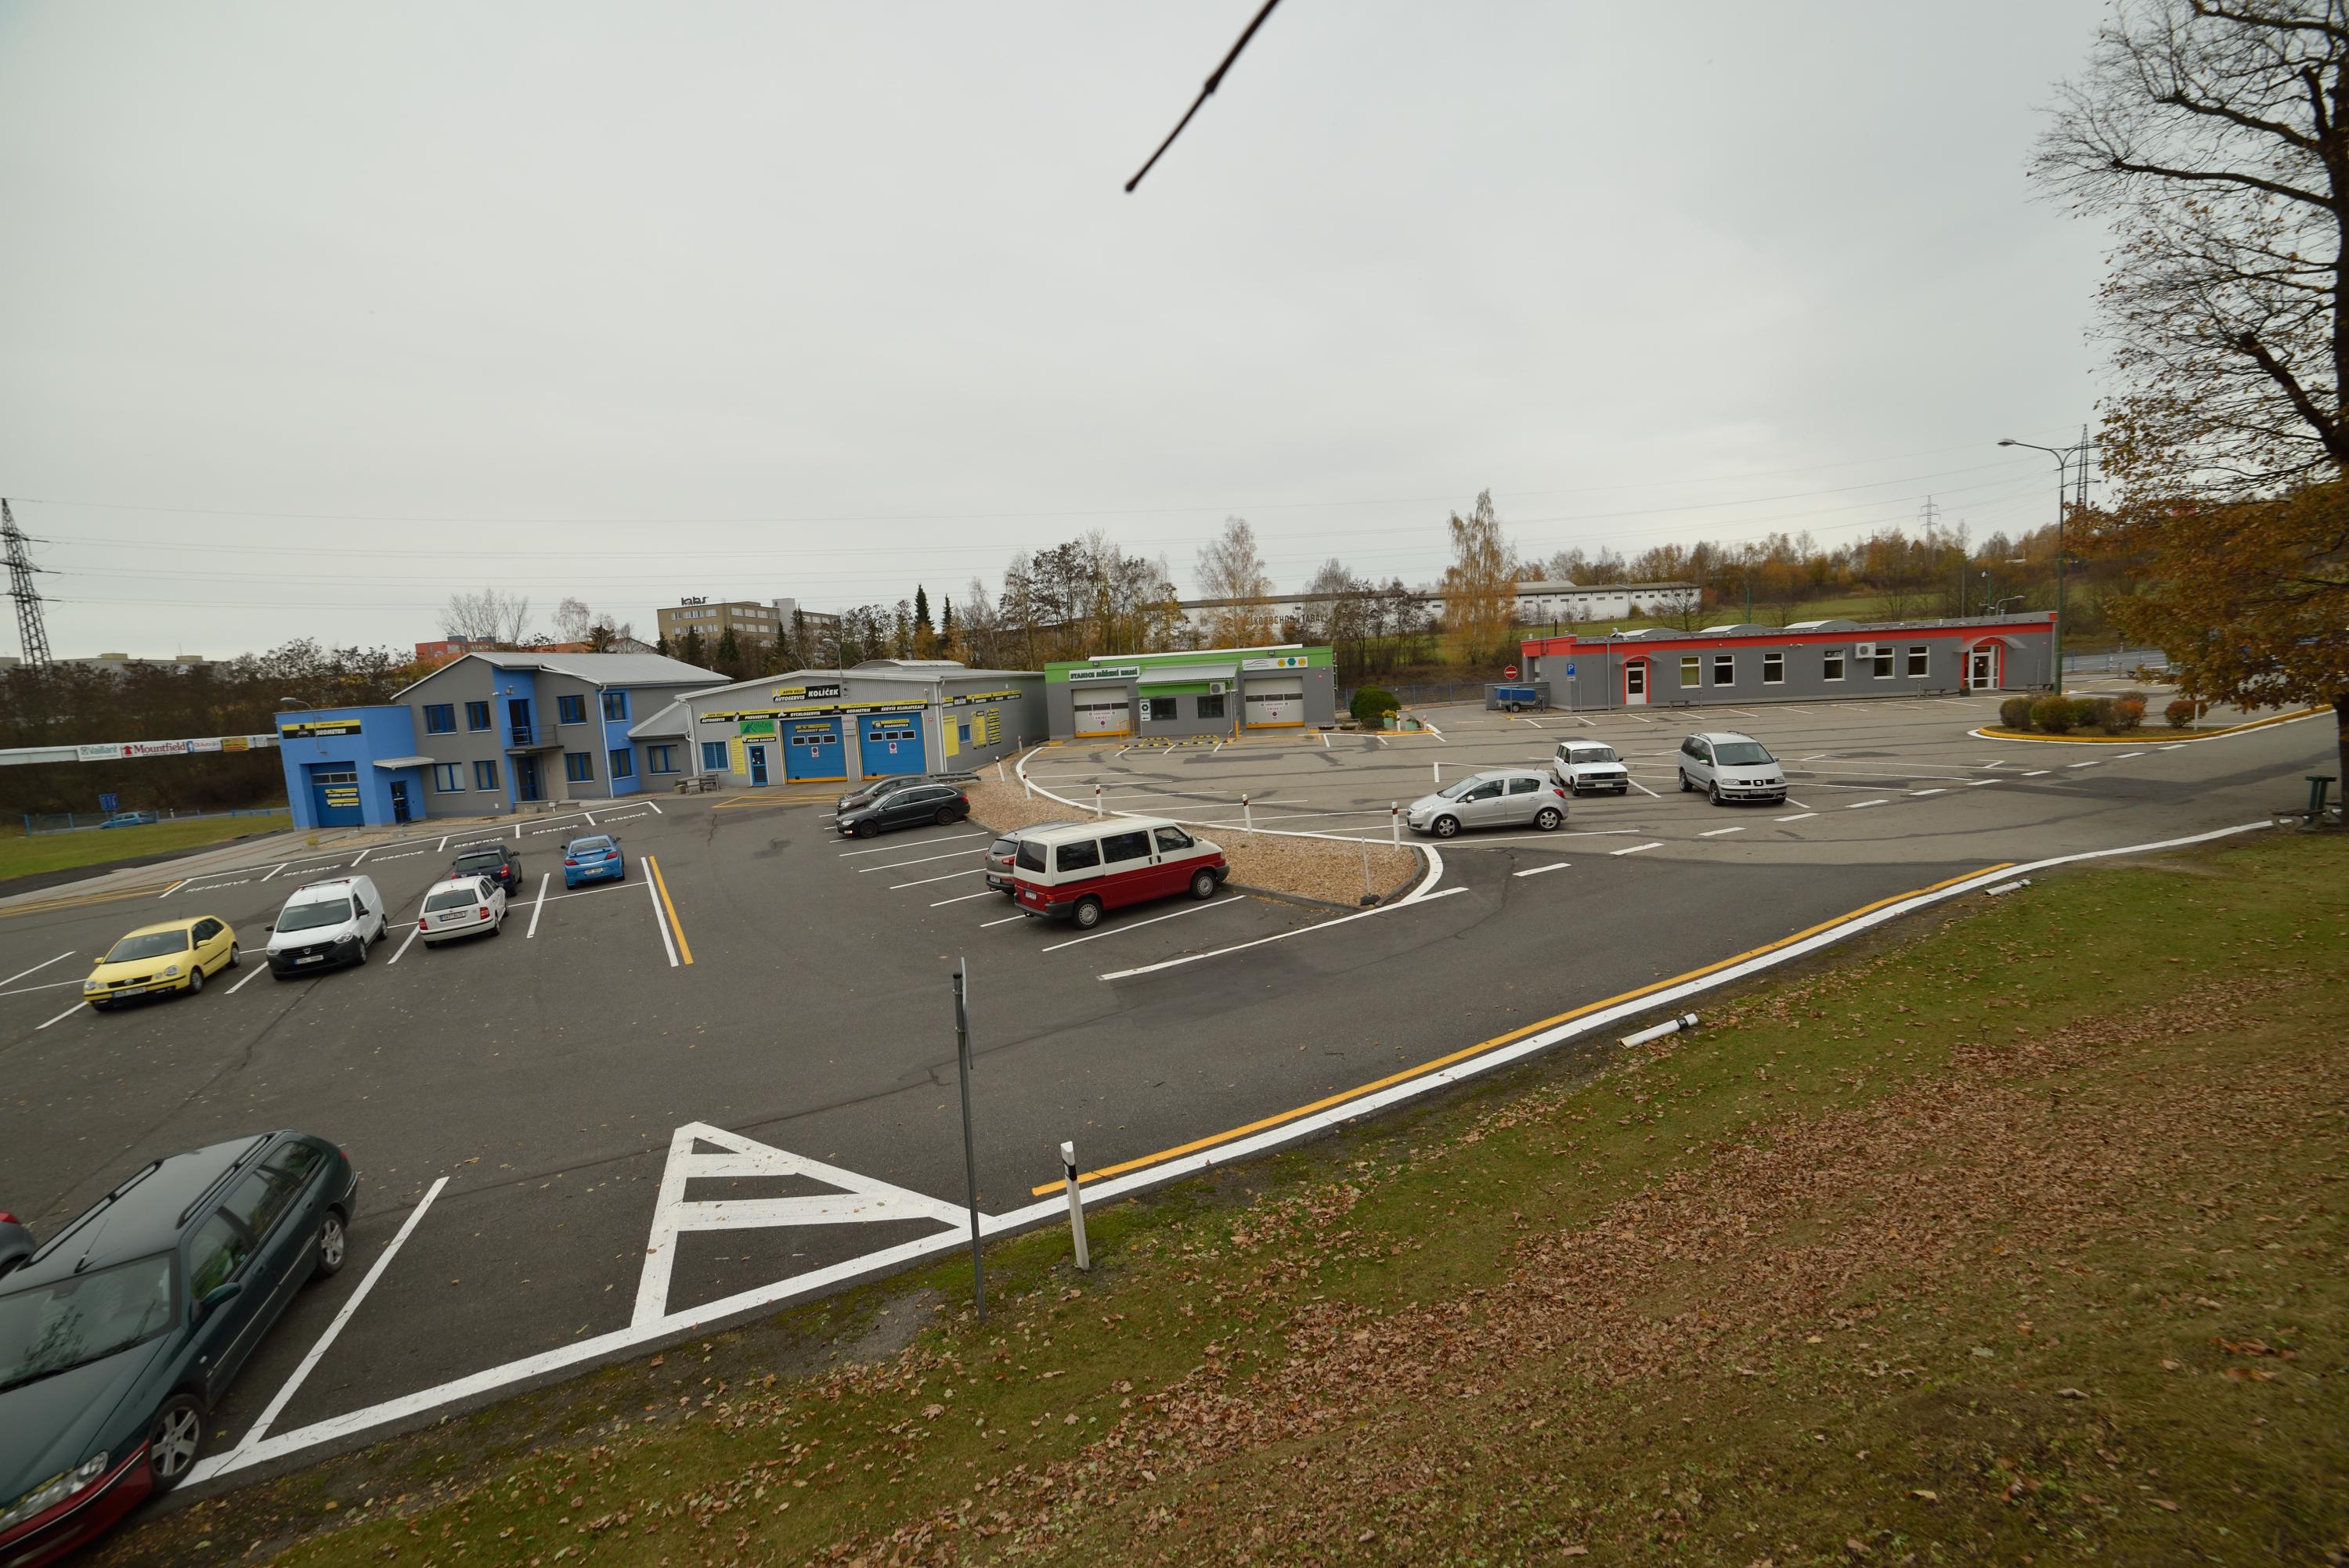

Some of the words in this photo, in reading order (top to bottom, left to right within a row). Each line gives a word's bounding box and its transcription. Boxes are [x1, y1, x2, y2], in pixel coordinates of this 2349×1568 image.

[808, 688, 839, 697] KOLÍČEK
[88, 744, 118, 755] Vaillant
[134, 741, 186, 754] Mountfield
